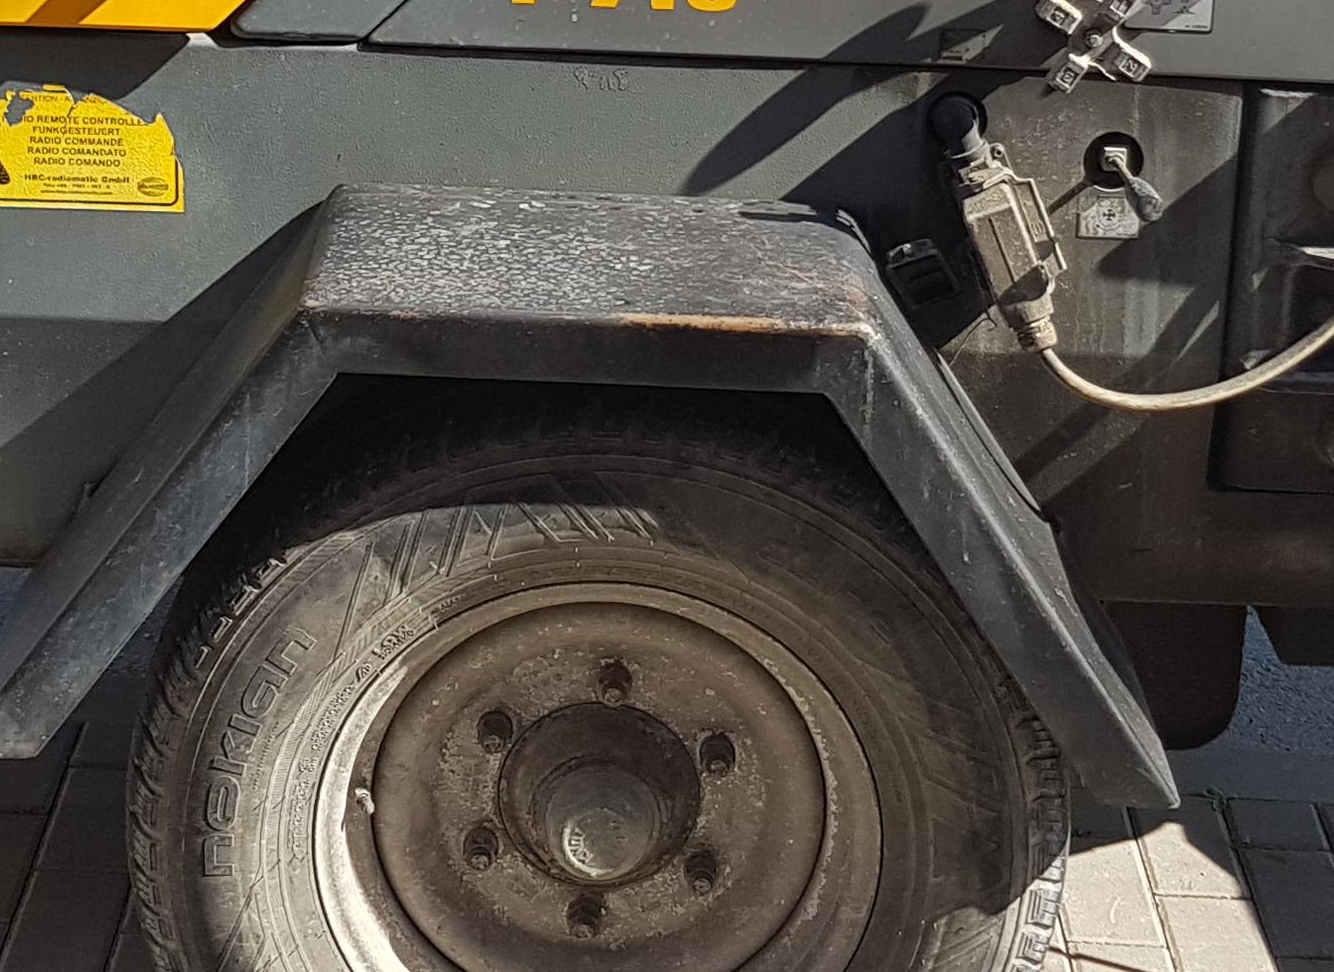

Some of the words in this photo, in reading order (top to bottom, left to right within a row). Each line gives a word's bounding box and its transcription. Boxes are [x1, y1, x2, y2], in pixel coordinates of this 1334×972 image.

[37, 115, 80, 125] REMOTE
[29, 136, 62, 145] RADIO
[65, 137, 124, 147] COMMANDE
[27, 146, 59, 155] RADIO
[62, 147, 126, 157] COMANDATO
[33, 157, 65, 165] RADIO
[68, 158, 121, 167] COMANDO
